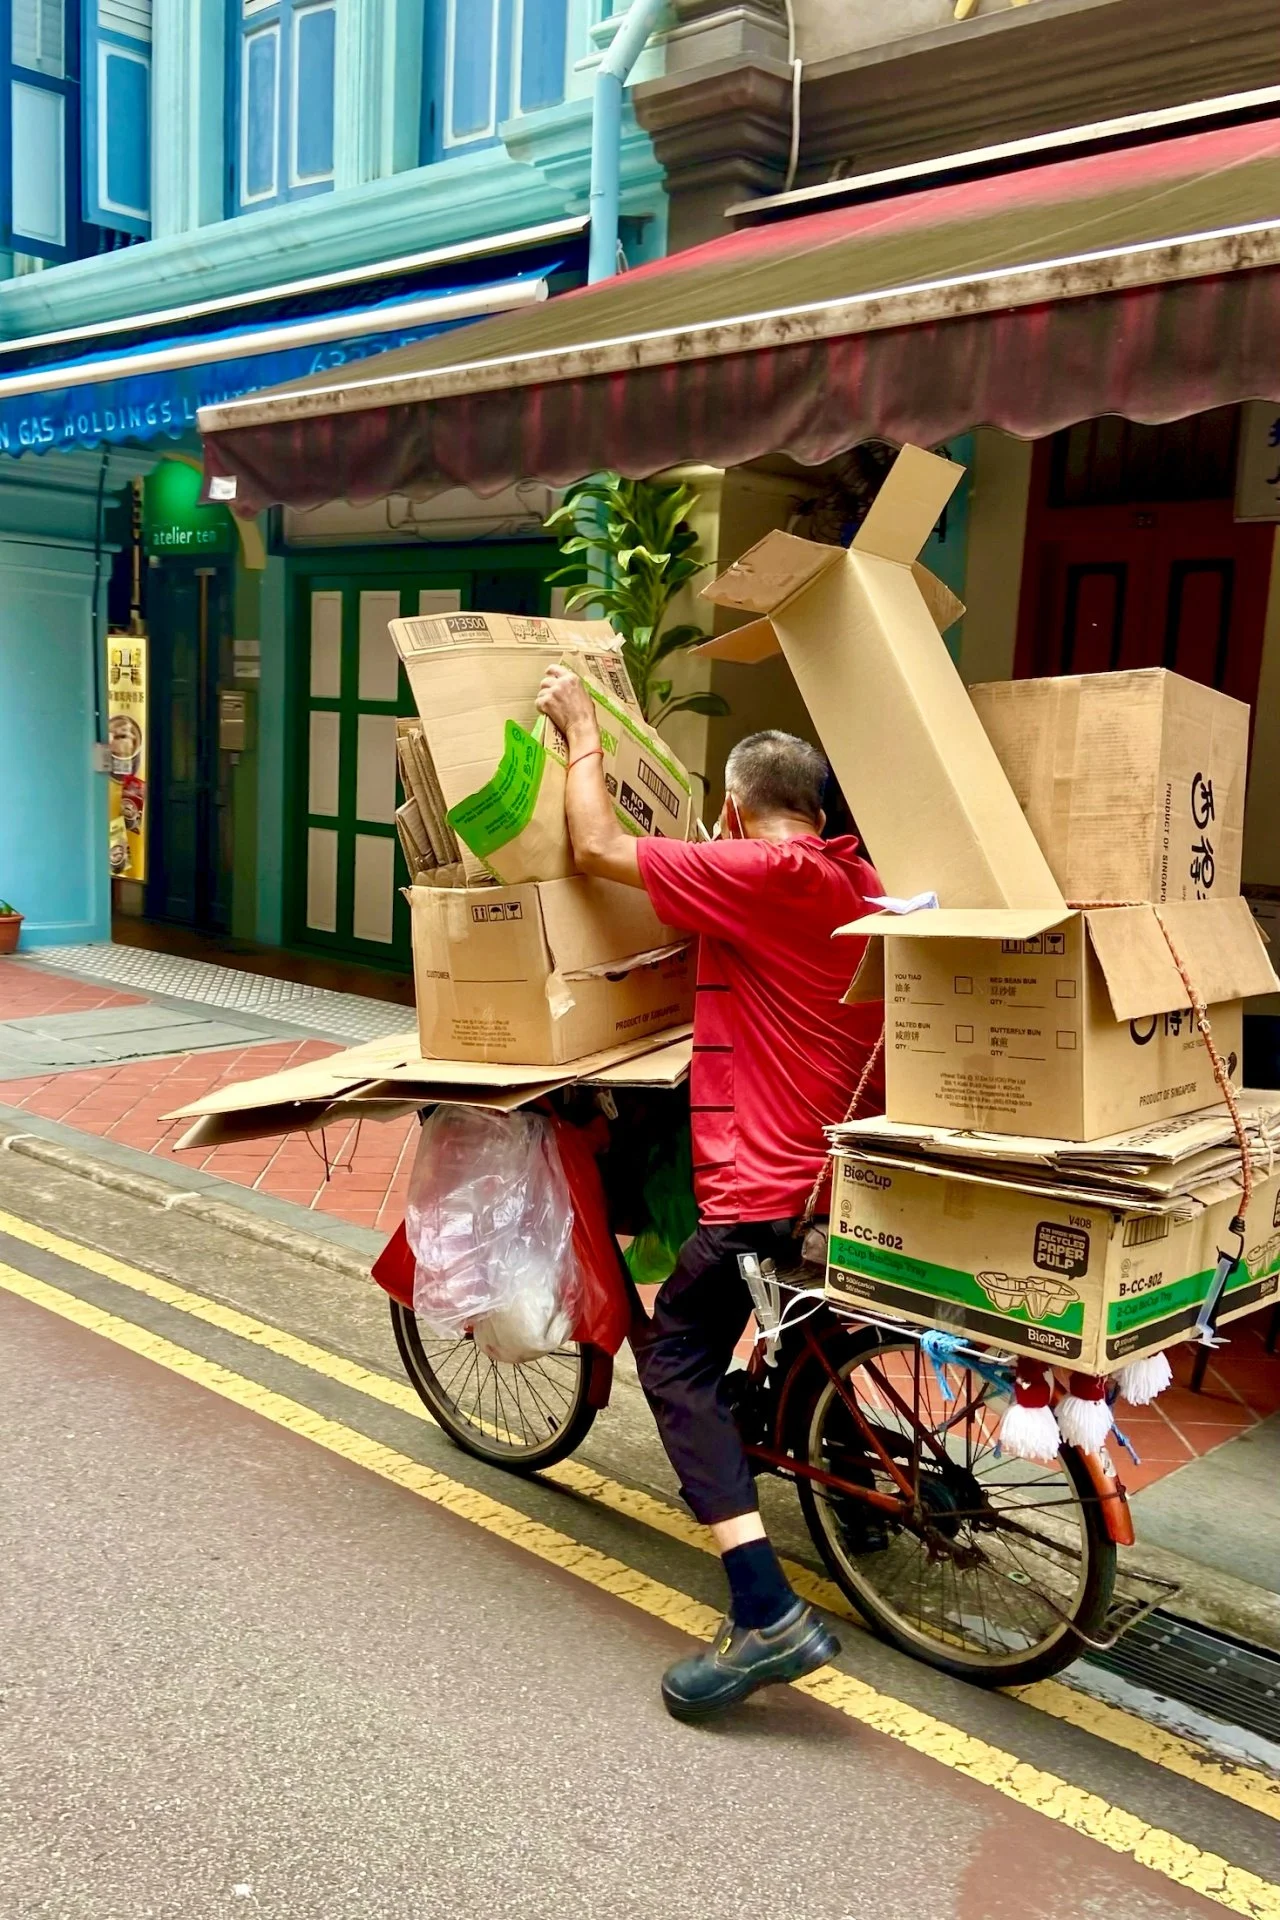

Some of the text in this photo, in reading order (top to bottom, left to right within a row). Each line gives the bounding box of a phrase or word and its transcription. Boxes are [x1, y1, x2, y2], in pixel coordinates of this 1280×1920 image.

[19, 417, 54, 446] GAS
[64, 401, 172, 437] HOLDINGS
[153, 526, 217, 545] atelier ten
[631, 789, 645, 810] NO
[620, 795, 651, 830] SUGAR
[1160, 783, 1172, 903] PRODUCT OF SINGAPO
[426, 969, 451, 980] CUSTOMER
[615, 1014, 642, 1032] PRODUCT
[642, 1012, 650, 1023] OF
[895, 1021, 917, 1029] SALTED
[990, 1027, 1026, 1036] BUTTERFLY
[1139, 1082, 1197, 1107] PRODUCT OF SINGAPORE
[843, 1164, 892, 1190] BioCup
[1068, 1214, 1092, 1229] V408
[839, 1220, 903, 1251] B-CC-802
[1039, 1232, 1086, 1249] RECYCLED
[838, 1243, 868, 1260] 2-Cup
[1038, 1240, 1085, 1261] PAPER
[1036, 1253, 1075, 1270] PULP
[1119, 1272, 1163, 1297] B-CC-802
[1027, 1328, 1070, 1350] BioPak
